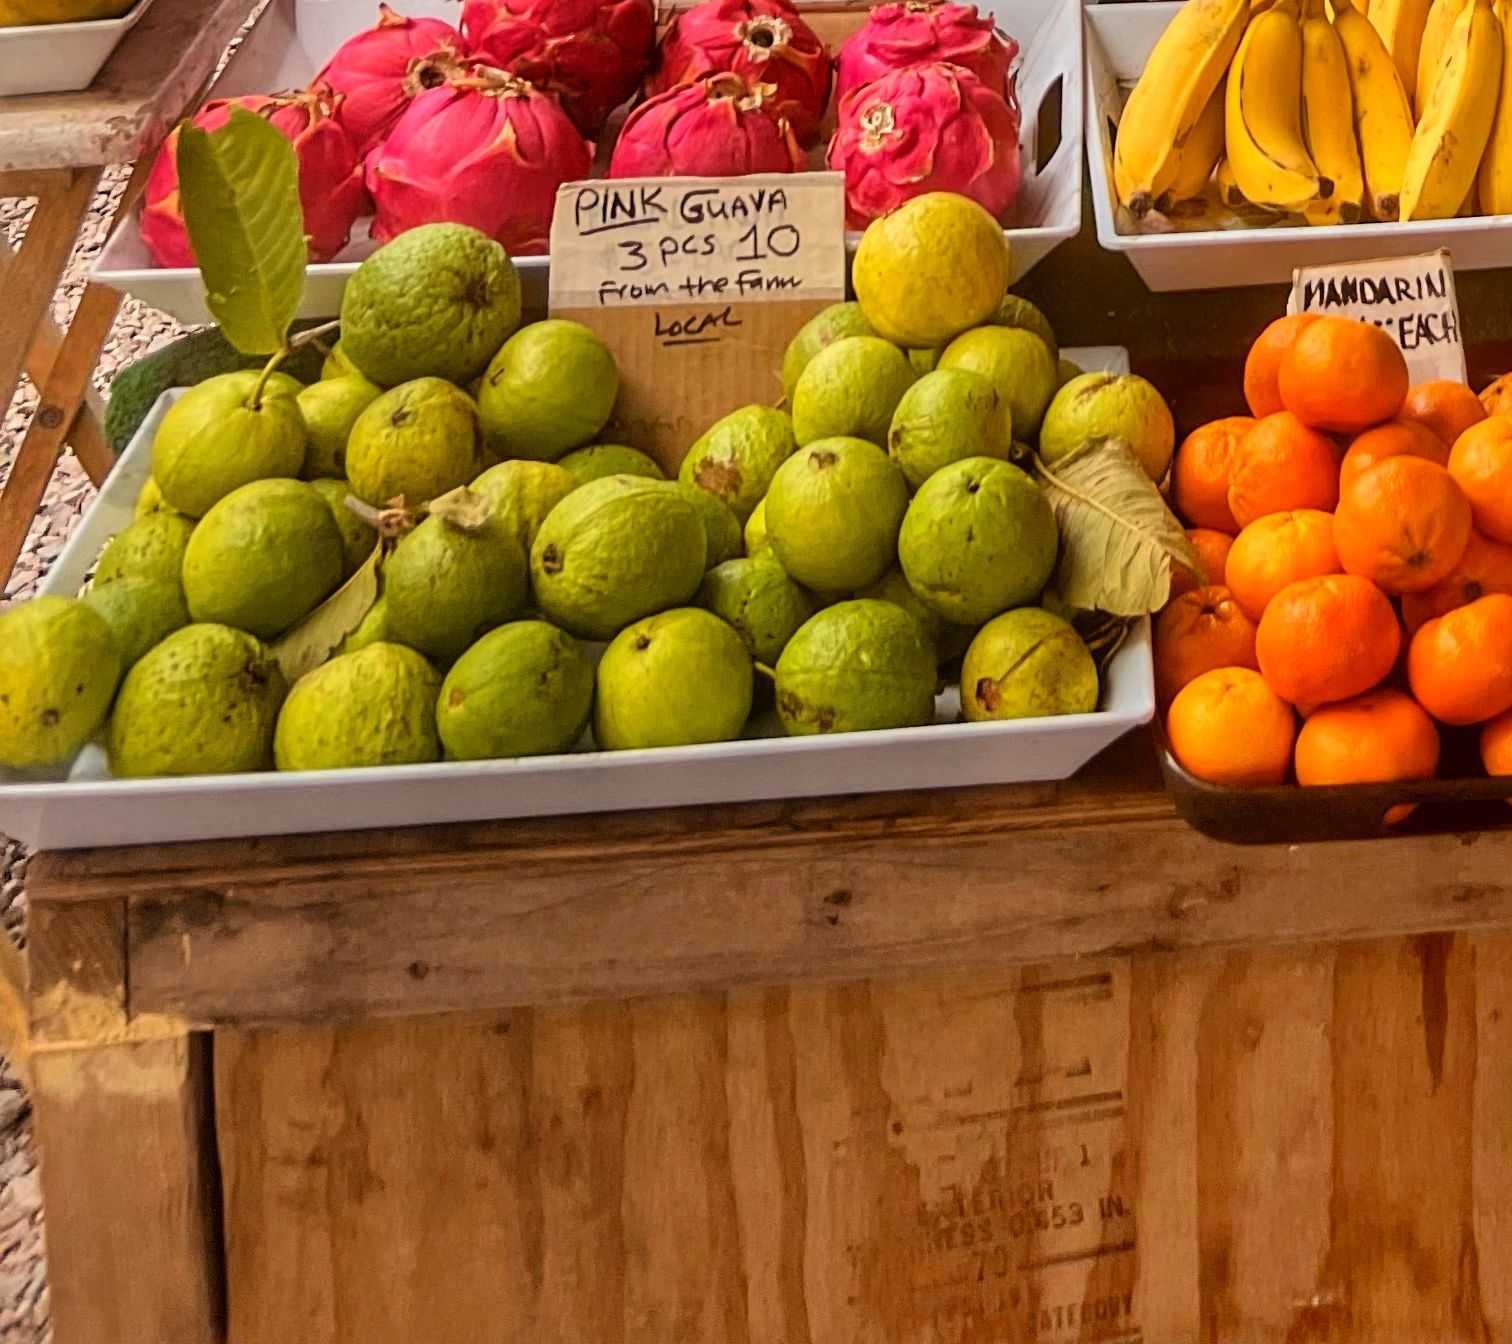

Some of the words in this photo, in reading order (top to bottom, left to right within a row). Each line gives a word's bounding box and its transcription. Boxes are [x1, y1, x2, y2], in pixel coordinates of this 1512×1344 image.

[575, 186, 668, 227] PINK
[680, 188, 788, 224] GUAVA
[617, 241, 648, 271] 3
[736, 223, 801, 262] 10
[679, 274, 730, 296] the
[1303, 267, 1447, 311] MANDARIN
[1398, 309, 1459, 350] EACH
